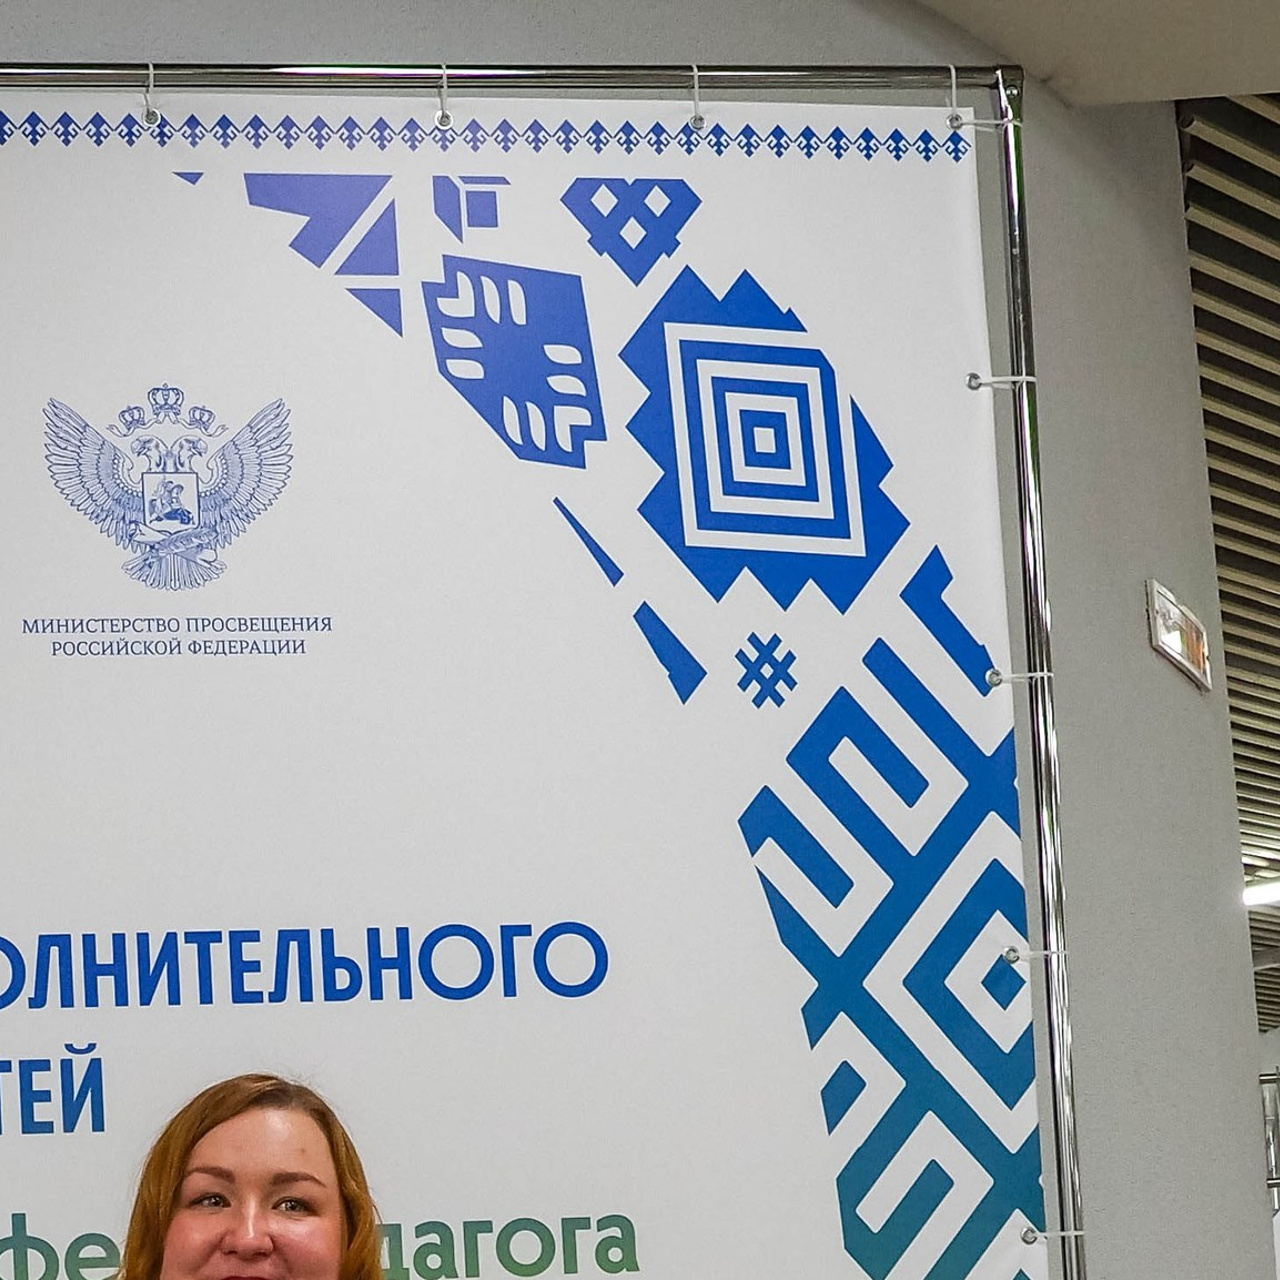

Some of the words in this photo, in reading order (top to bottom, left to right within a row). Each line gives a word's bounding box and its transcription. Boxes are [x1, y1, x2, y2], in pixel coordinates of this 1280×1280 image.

[22, 617, 180, 634] МИНИСТЕРСТВО
[186, 616, 333, 634] ПРОСВЕЩЕНИЯ
[51, 638, 182, 656] РОССИЙСКОЙ
[188, 639, 306, 657] ФЕДЕРАЦИИ
